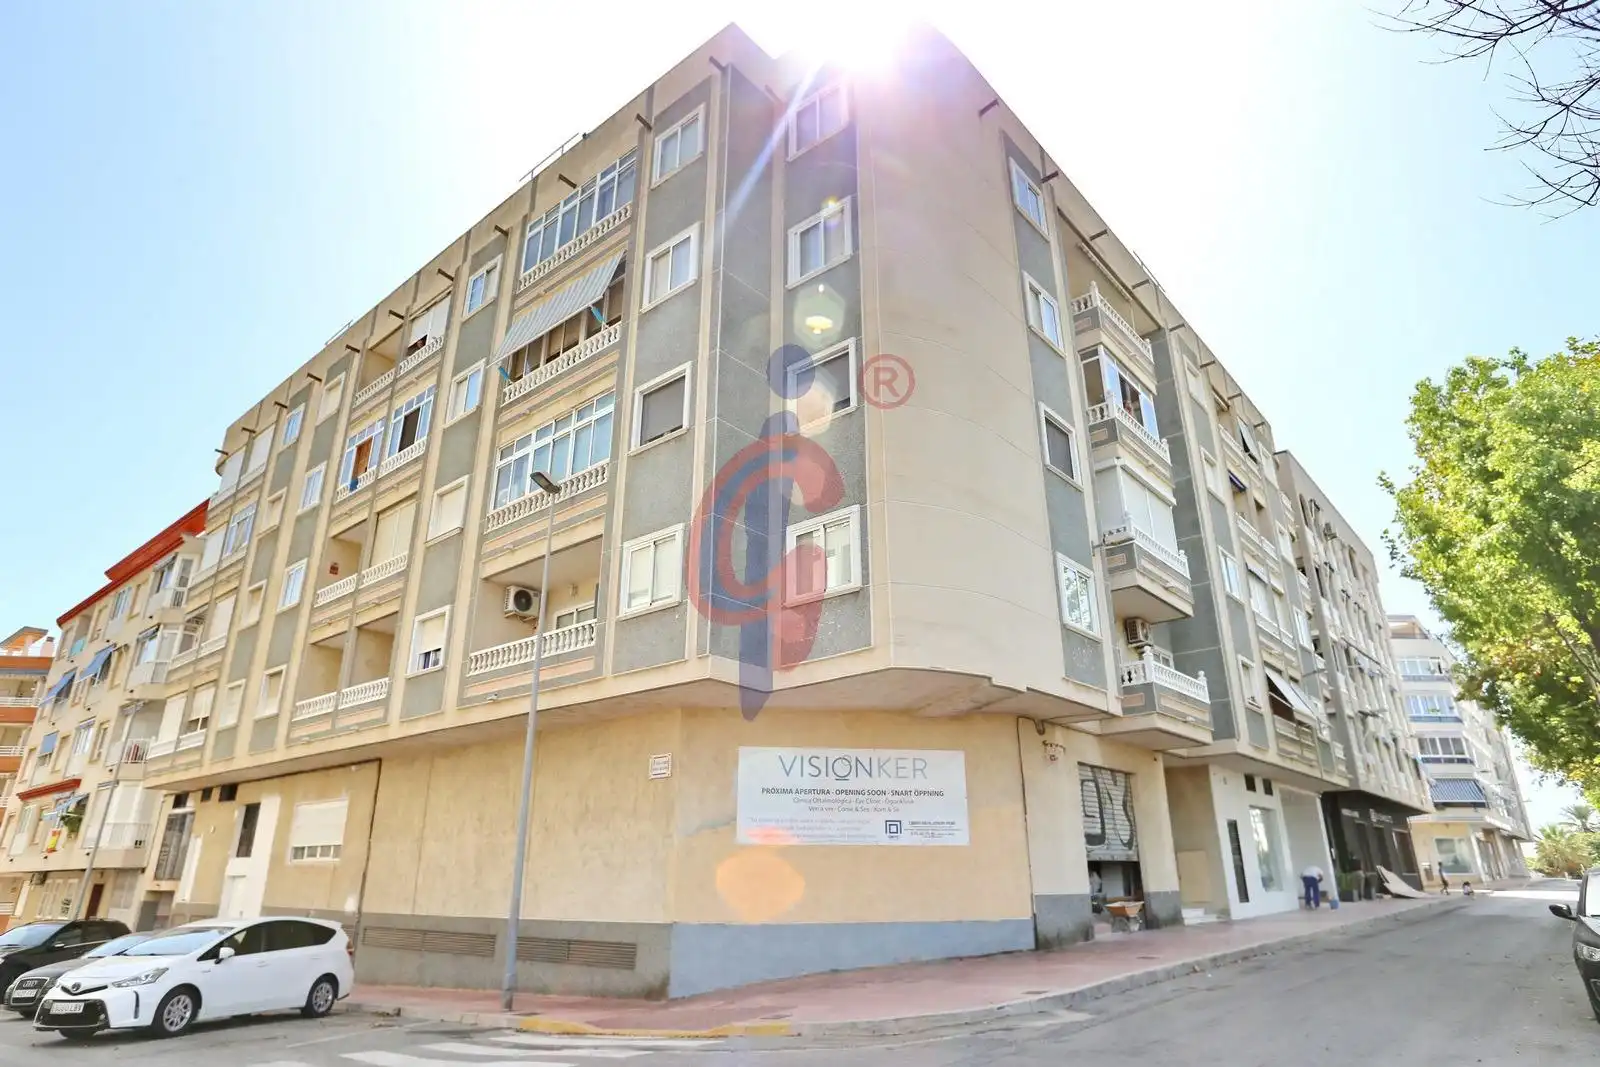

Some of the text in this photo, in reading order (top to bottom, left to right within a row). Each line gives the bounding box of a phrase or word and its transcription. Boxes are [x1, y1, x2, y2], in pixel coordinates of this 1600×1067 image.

[778, 755, 928, 780] VISIONKER
[761, 787, 794, 795] PRÓXIMA
[795, 788, 831, 796] APERTURA
[913, 789, 944, 797] ÖPPNING
